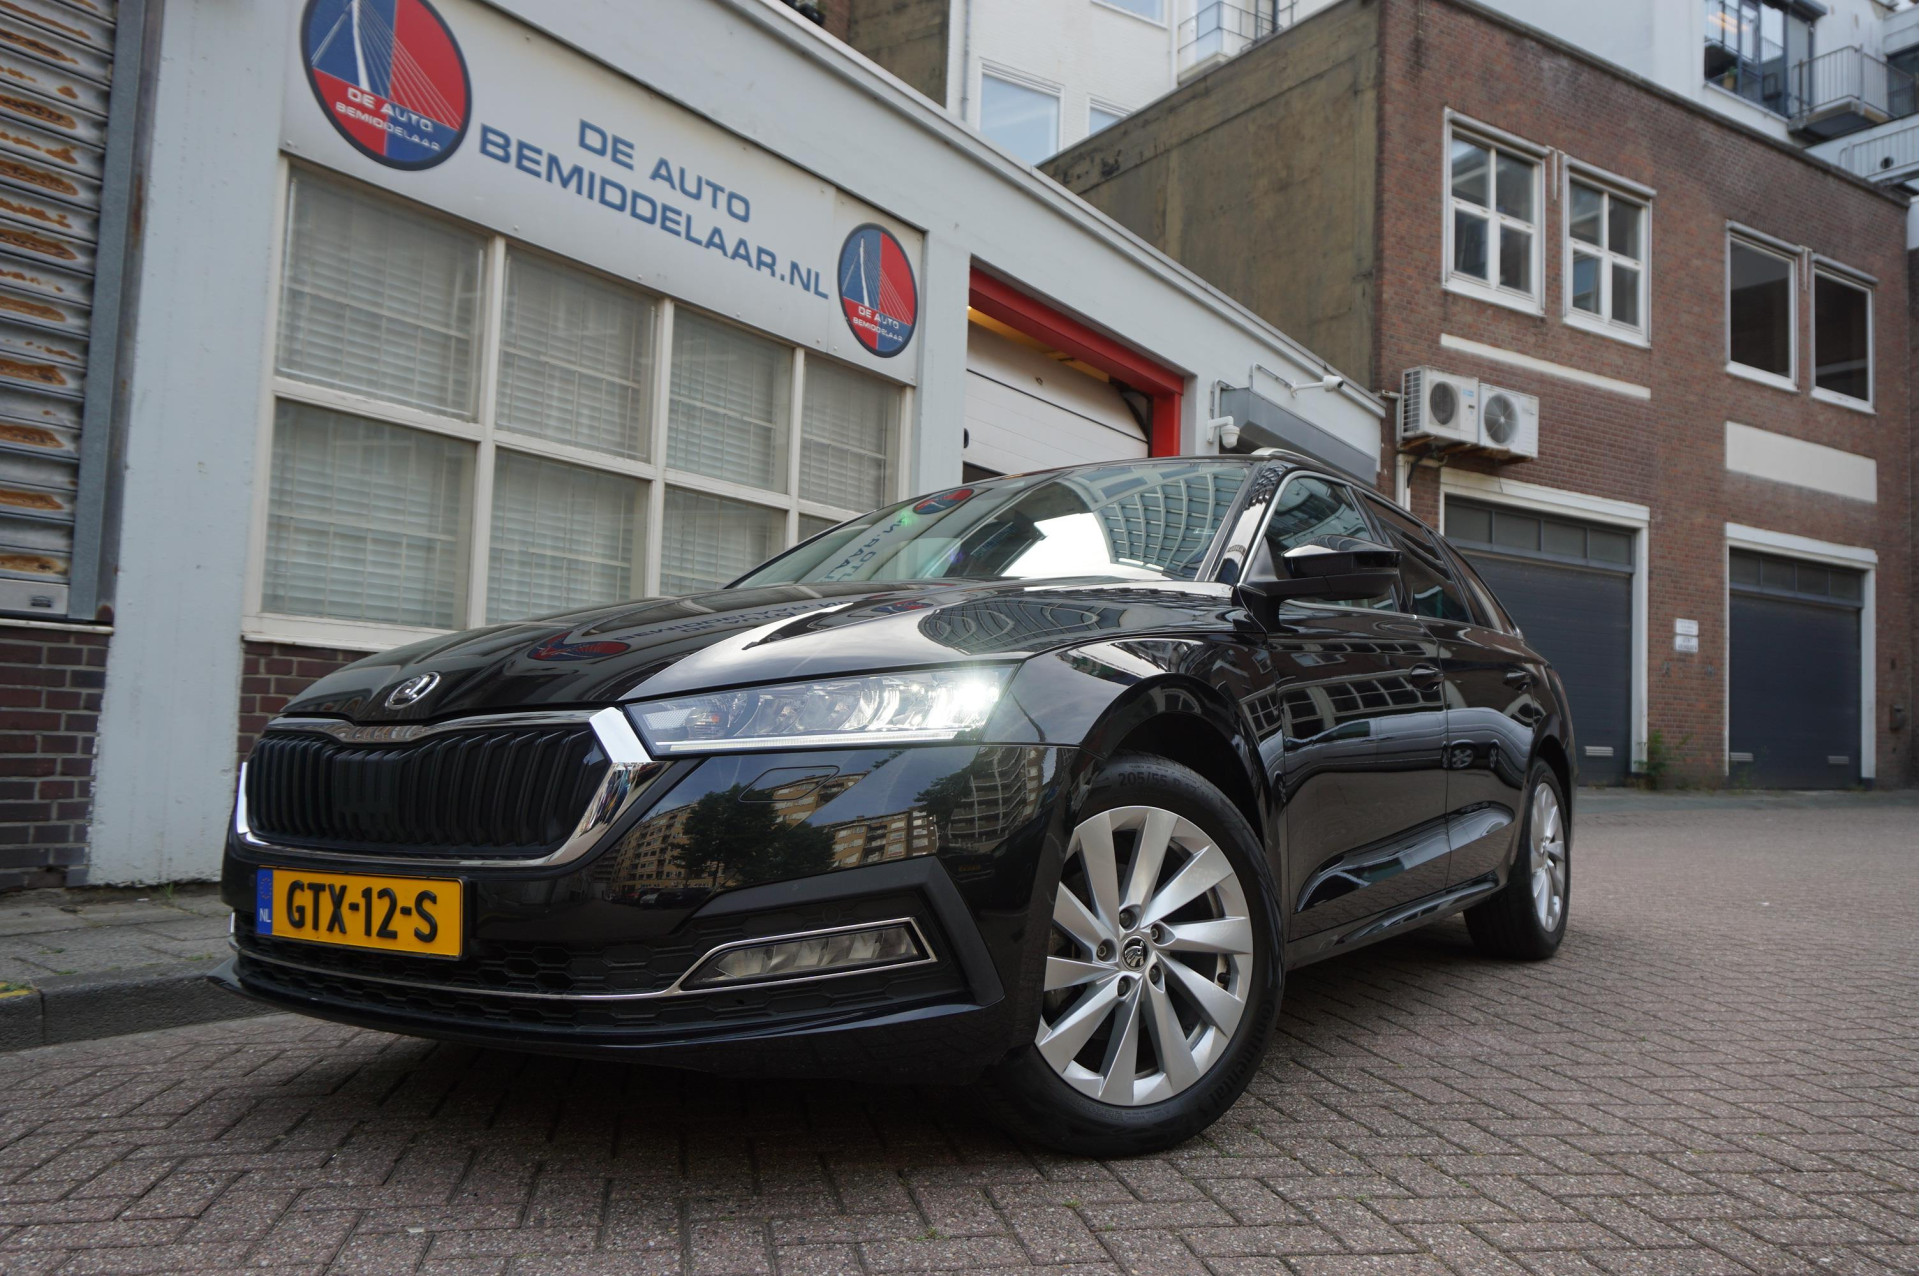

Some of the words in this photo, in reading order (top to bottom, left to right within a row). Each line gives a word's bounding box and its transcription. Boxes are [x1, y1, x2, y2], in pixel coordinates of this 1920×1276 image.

[335, 101, 440, 151] BEMIDDELAAR
[347, 87, 375, 110] DE
[380, 103, 434, 132] AUTO
[578, 118, 635, 171] DE
[649, 157, 751, 223] AUTO
[479, 123, 829, 300] BEMIDDELAAR.NL
[853, 316, 903, 342] BEMIDDELAAR
[858, 305, 872, 318] DE
[874, 313, 899, 329] AUTO
[1117, 771, 1168, 787] 205/55
[259, 908, 272, 923] NL
[286, 879, 438, 943] GTX-12-S
